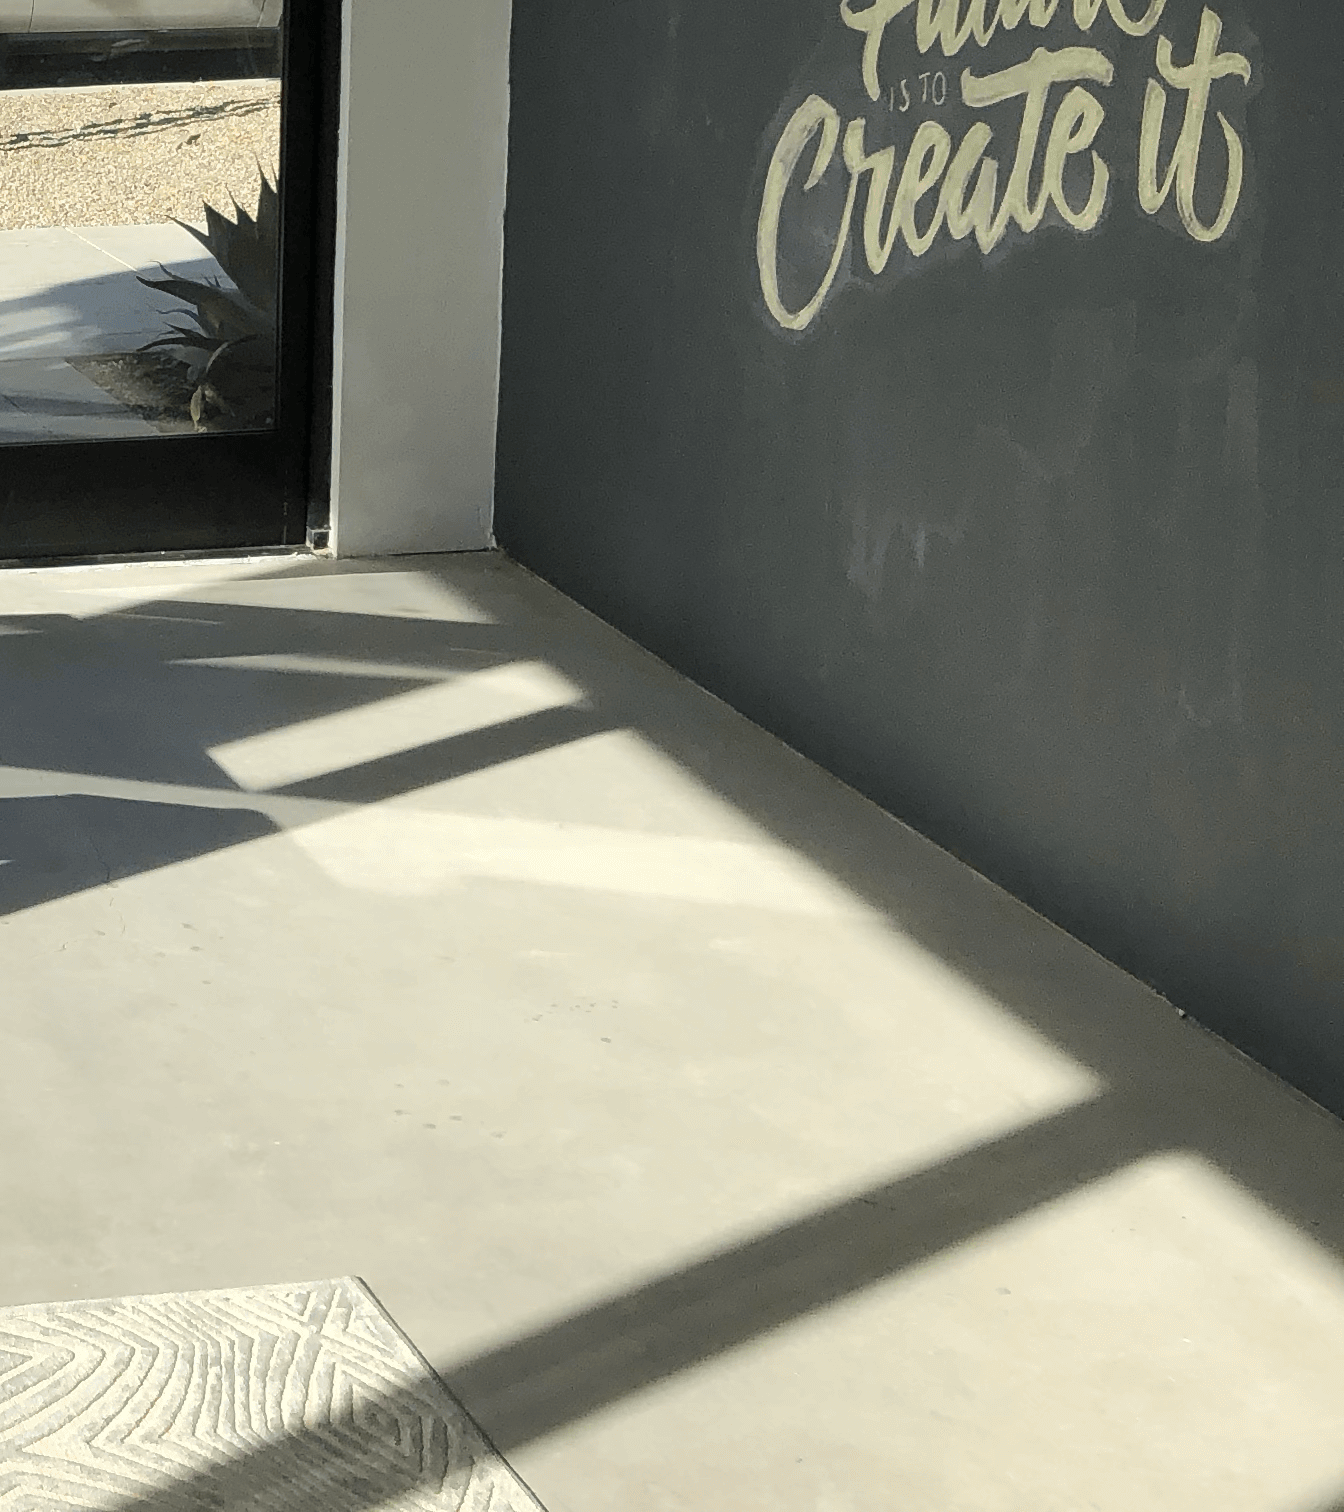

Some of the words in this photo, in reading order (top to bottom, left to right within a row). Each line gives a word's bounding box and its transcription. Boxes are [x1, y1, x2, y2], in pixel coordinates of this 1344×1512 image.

[757, 47, 1115, 330] Create
[1138, 6, 1252, 243] it
[888, 78, 911, 113] IS
[918, 71, 947, 106] TO
